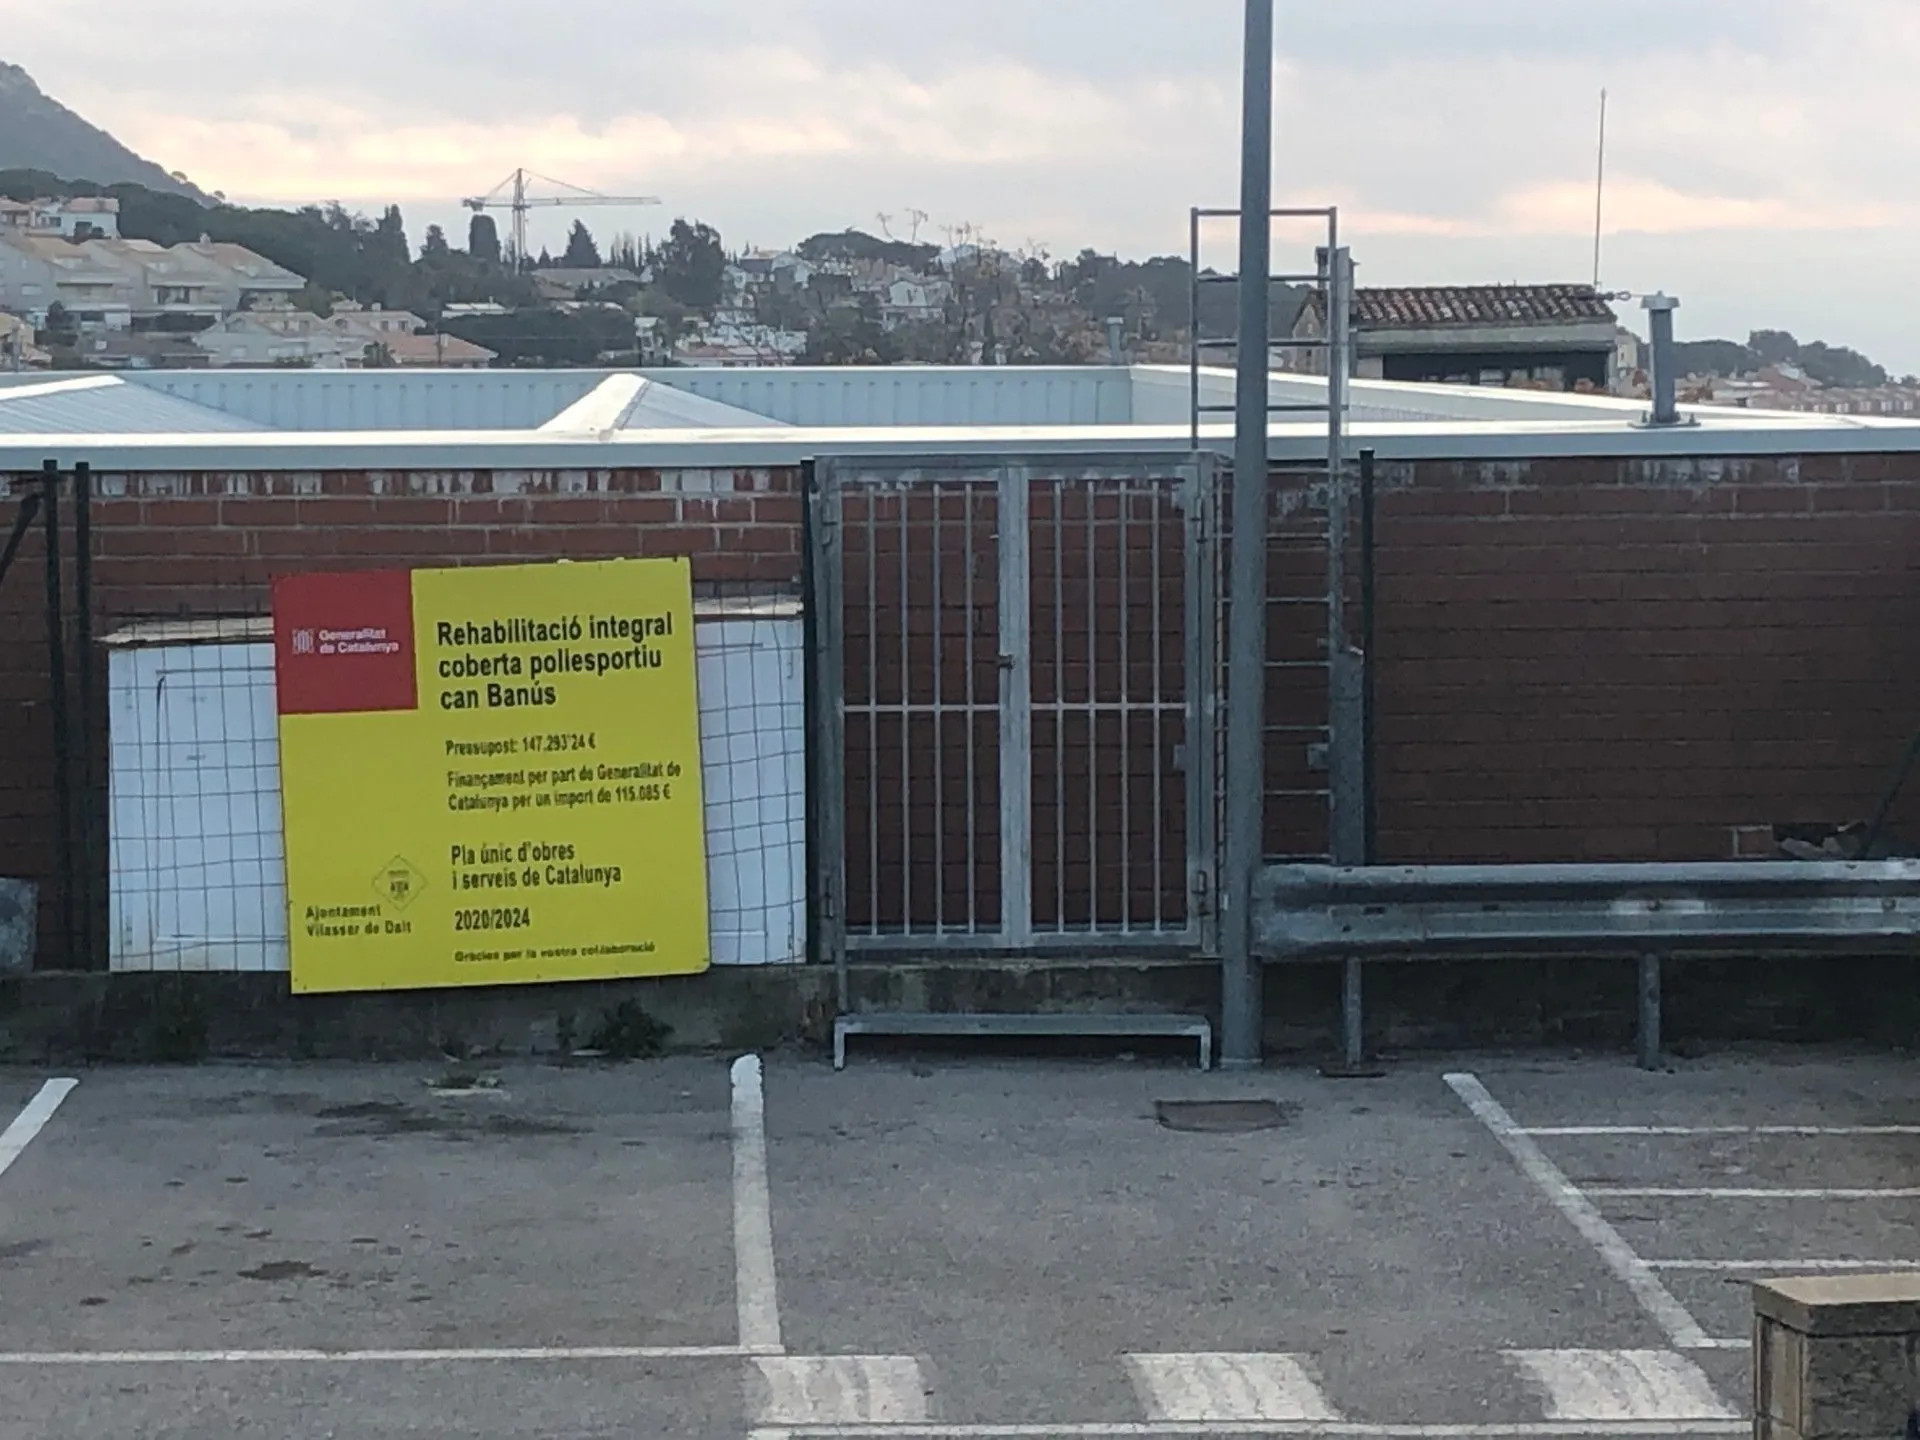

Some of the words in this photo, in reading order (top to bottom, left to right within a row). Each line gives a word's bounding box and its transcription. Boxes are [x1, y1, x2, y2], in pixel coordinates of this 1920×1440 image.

[437, 615, 583, 646] Rehabilitació
[589, 611, 674, 643] integral
[320, 641, 335, 654] de
[337, 641, 400, 654] Catalunya
[438, 653, 523, 678] coberta
[530, 645, 662, 680] poliesportiu
[440, 688, 480, 710] can
[487, 680, 557, 708] Banús
[588, 732, 597, 749] €
[447, 770, 525, 790] Finançament
[528, 771, 548, 788] per
[552, 767, 576, 786] part
[579, 765, 594, 781] de
[597, 762, 663, 780] Generalitat
[667, 761, 681, 777] de
[448, 793, 509, 812] Catalunya
[512, 794, 532, 811] per
[535, 793, 551, 807] un
[554, 789, 594, 809] import
[597, 787, 612, 803] de
[662, 783, 671, 800] €
[451, 844, 475, 866] Pla
[480, 841, 513, 865] únic
[518, 840, 575, 862] d'obres
[452, 870, 458, 890] i
[462, 868, 517, 890] serveis
[522, 866, 541, 887] de
[545, 863, 622, 888] Catalunya
[364, 921, 380, 935] de
[384, 920, 412, 934] Dalt
[454, 907, 531, 931] 2020/2024
